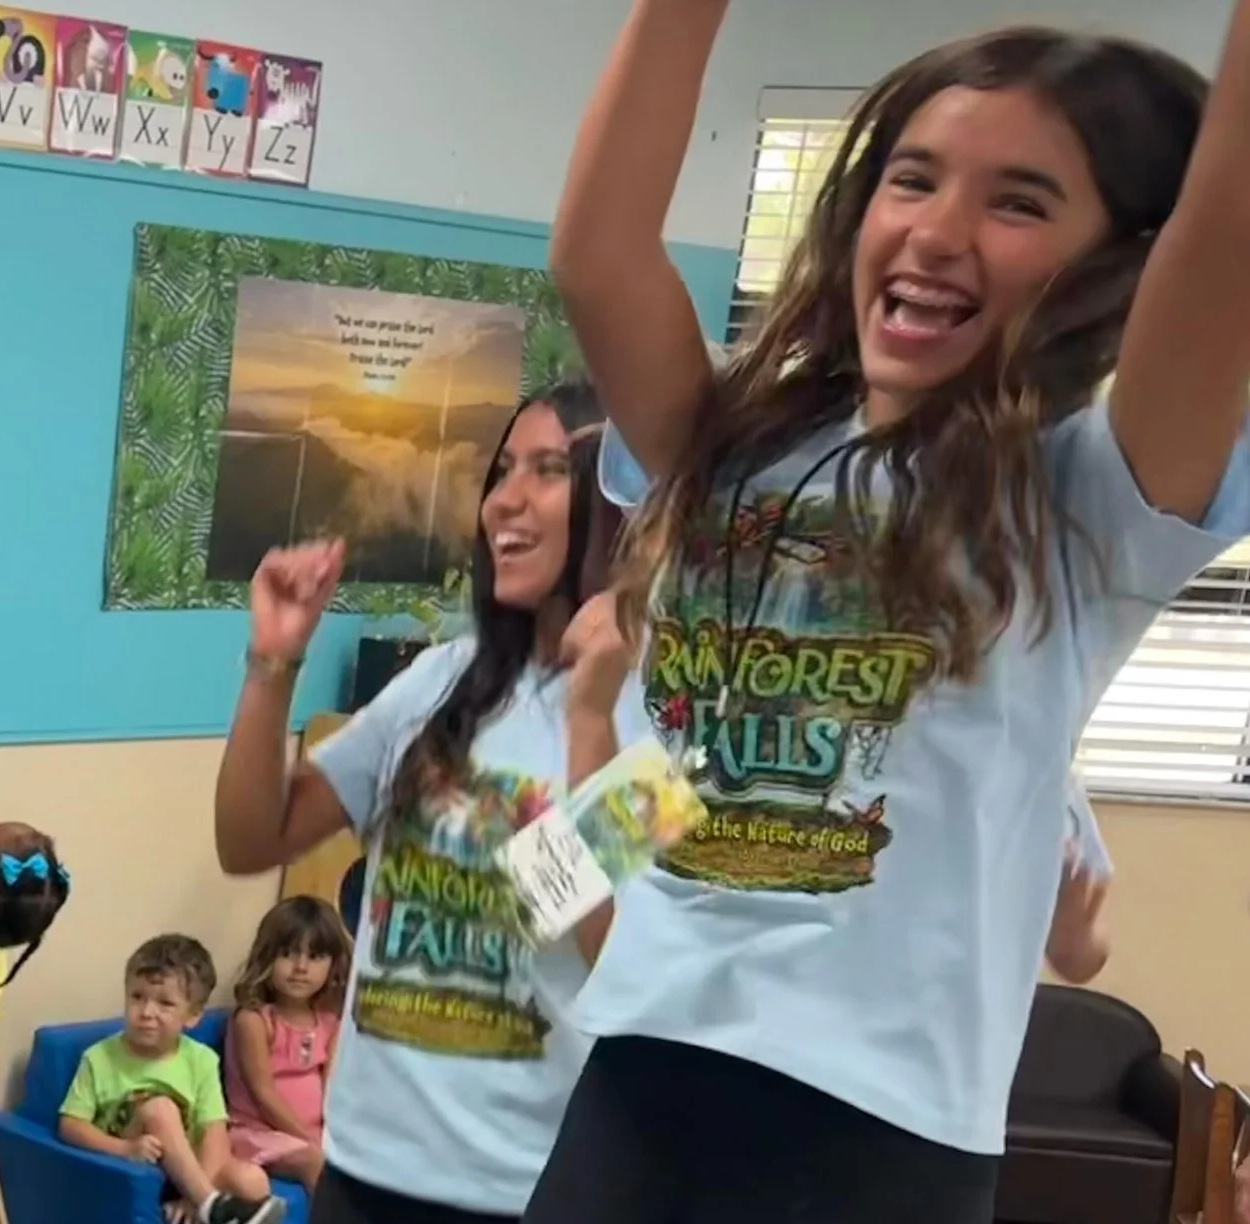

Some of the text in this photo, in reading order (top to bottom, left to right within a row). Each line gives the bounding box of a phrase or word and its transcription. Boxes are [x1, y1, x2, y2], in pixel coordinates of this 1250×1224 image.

[58, 91, 111, 137] Ww
[133, 104, 170, 147] Xx
[203, 113, 236, 171] Yy
[263, 125, 299, 165] Zz
[653, 632, 927, 706] RAINFOREST
[693, 701, 842, 779] FALLS
[713, 815, 743, 839] the
[747, 821, 806, 846] Nature
[830, 829, 870, 852] God
